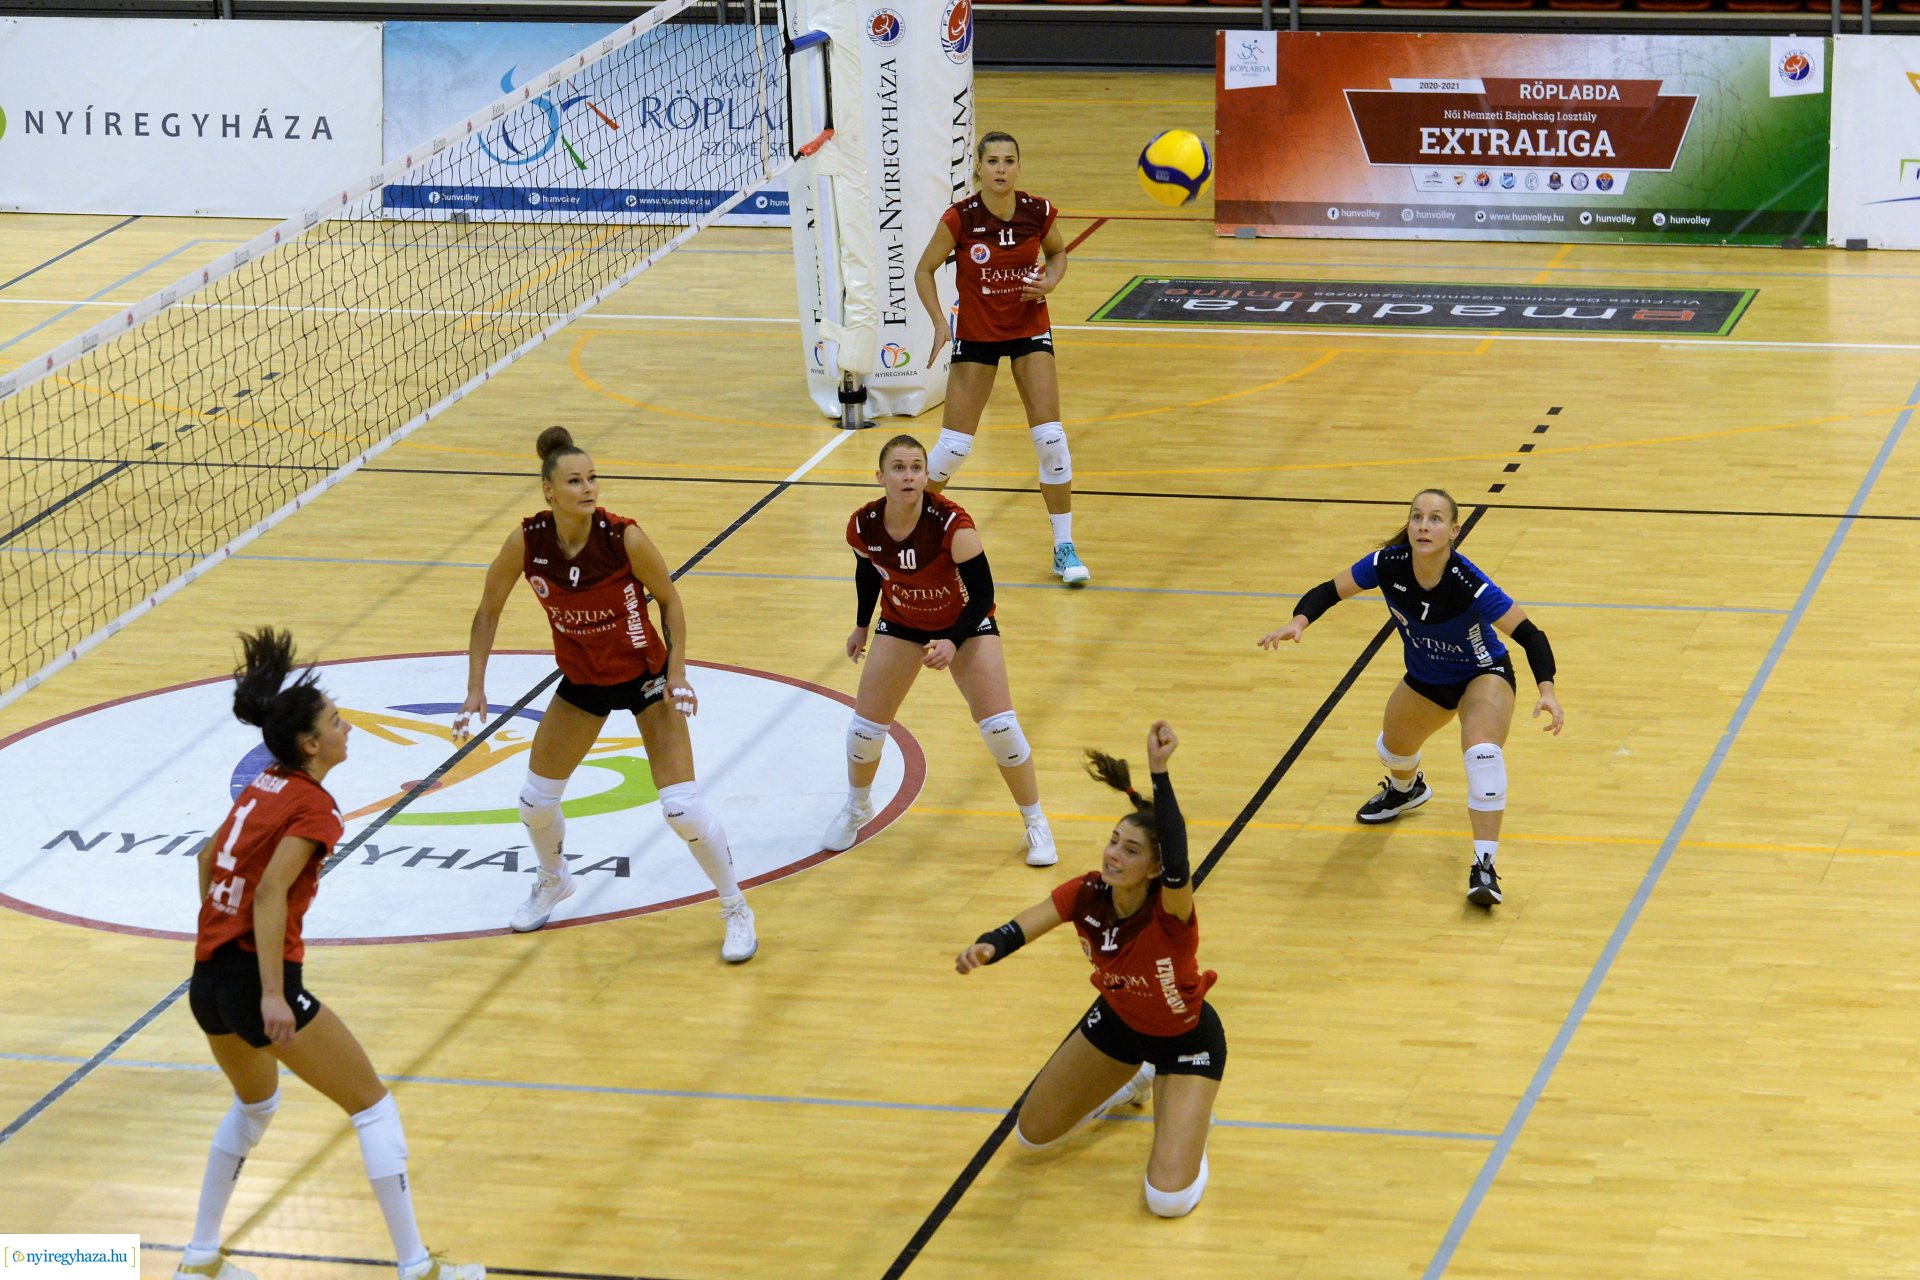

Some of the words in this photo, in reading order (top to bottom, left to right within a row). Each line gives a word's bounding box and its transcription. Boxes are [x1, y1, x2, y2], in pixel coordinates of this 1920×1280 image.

[1419, 81, 1460, 90] 2020-2021
[1519, 80, 1621, 101] RÖPLABDA
[641, 89, 784, 131] RÖPLA
[1444, 110, 1461, 119] Női
[1463, 110, 1503, 120] Nemzeti
[1505, 110, 1555, 122] Bajnokság
[25, 105, 333, 140] NYÍREGYHÁZA
[1419, 127, 1616, 157] EXTRALIGA
[878, 57, 907, 328] FATUM-NYÍREGYHÁZA
[1341, 208, 1381, 219] hunvolley
[1416, 210, 1456, 221] hunvolley
[1489, 212, 1564, 223] www.hunvolley.hu
[1596, 215, 1636, 225] hunvolley
[1670, 214, 1711, 226] hunvolley
[998, 228, 1016, 246] 11
[875, 370, 918, 378] NYÍREGYHÁZA
[898, 549, 917, 570] 10
[569, 566, 580, 587] 9
[1420, 601, 1430, 621] 7
[216, 799, 257, 871] 1
[40, 830, 630, 878] NYÍYHÁA
